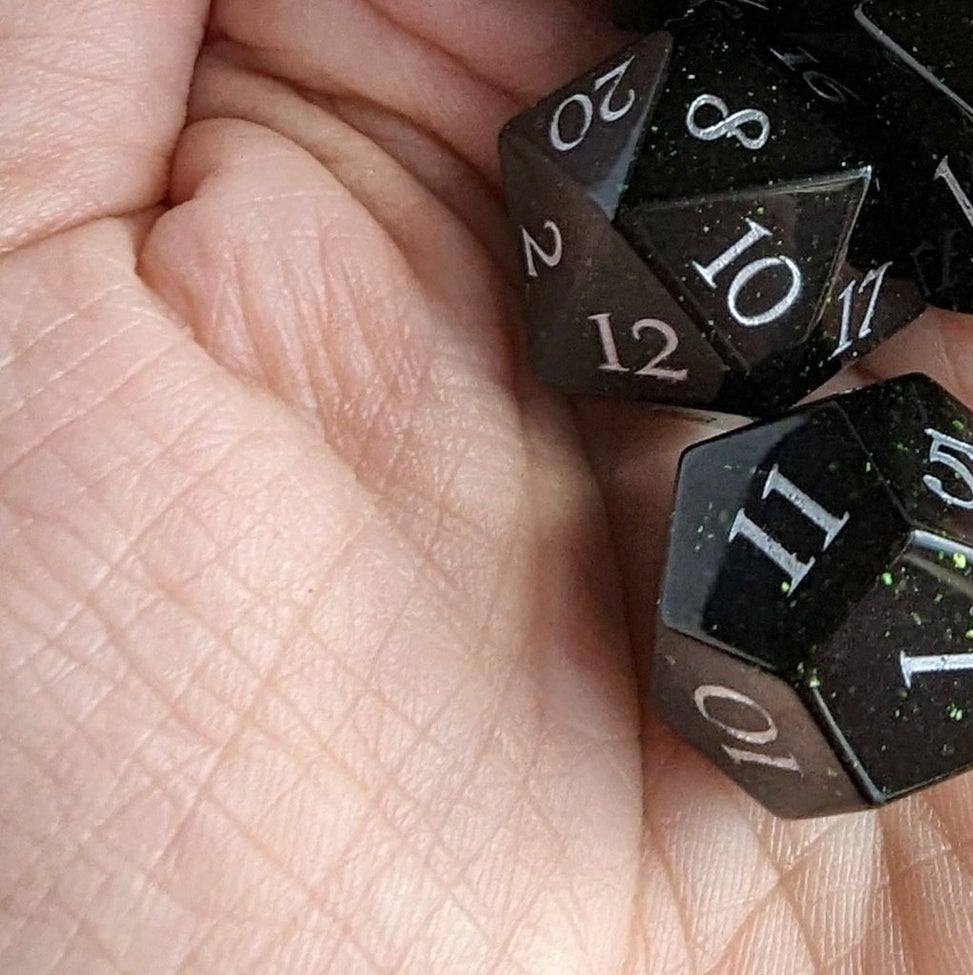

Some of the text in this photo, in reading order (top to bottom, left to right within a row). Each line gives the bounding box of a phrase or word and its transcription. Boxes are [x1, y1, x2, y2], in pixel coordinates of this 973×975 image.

[546, 56, 638, 152] 20
[685, 93, 771, 151] 8
[520, 220, 565, 280] 2
[692, 218, 803, 328] 10
[586, 311, 690, 383] 12
[828, 261, 895, 361] 17
[726, 462, 852, 599] 11
[692, 682, 804, 777] 10
